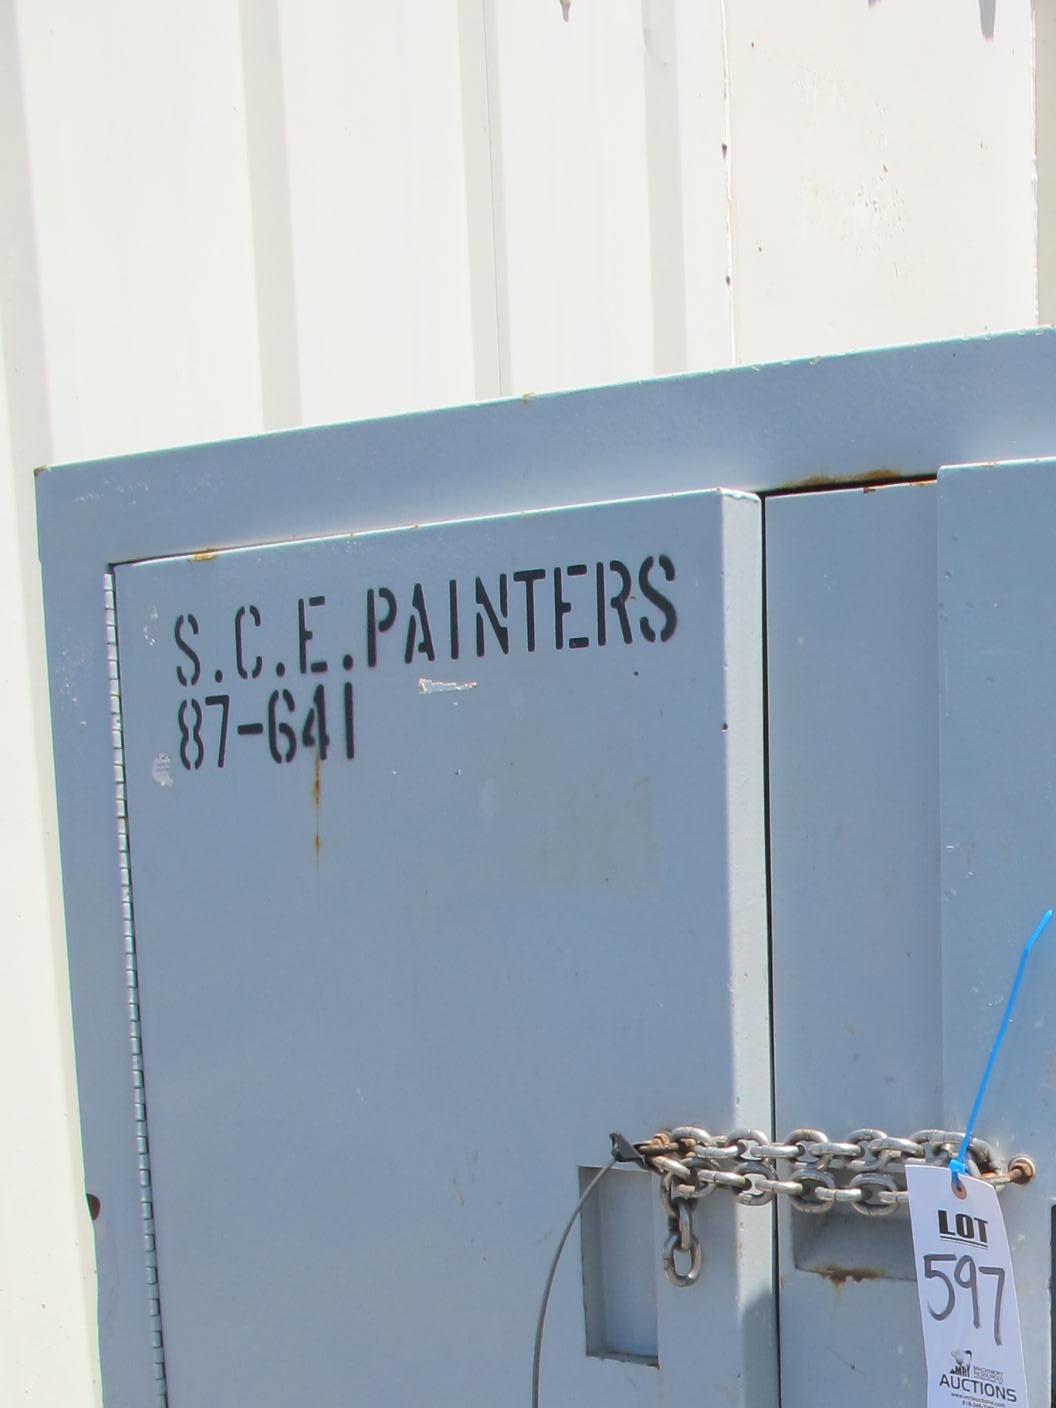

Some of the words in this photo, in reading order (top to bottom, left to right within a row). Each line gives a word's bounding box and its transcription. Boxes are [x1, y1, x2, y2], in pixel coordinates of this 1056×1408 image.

[178, 682, 355, 771] 87-641
[938, 1209, 988, 1244] LOT
[923, 1253, 1005, 1346] 597
[939, 1374, 1017, 1403] AUCTIONS
